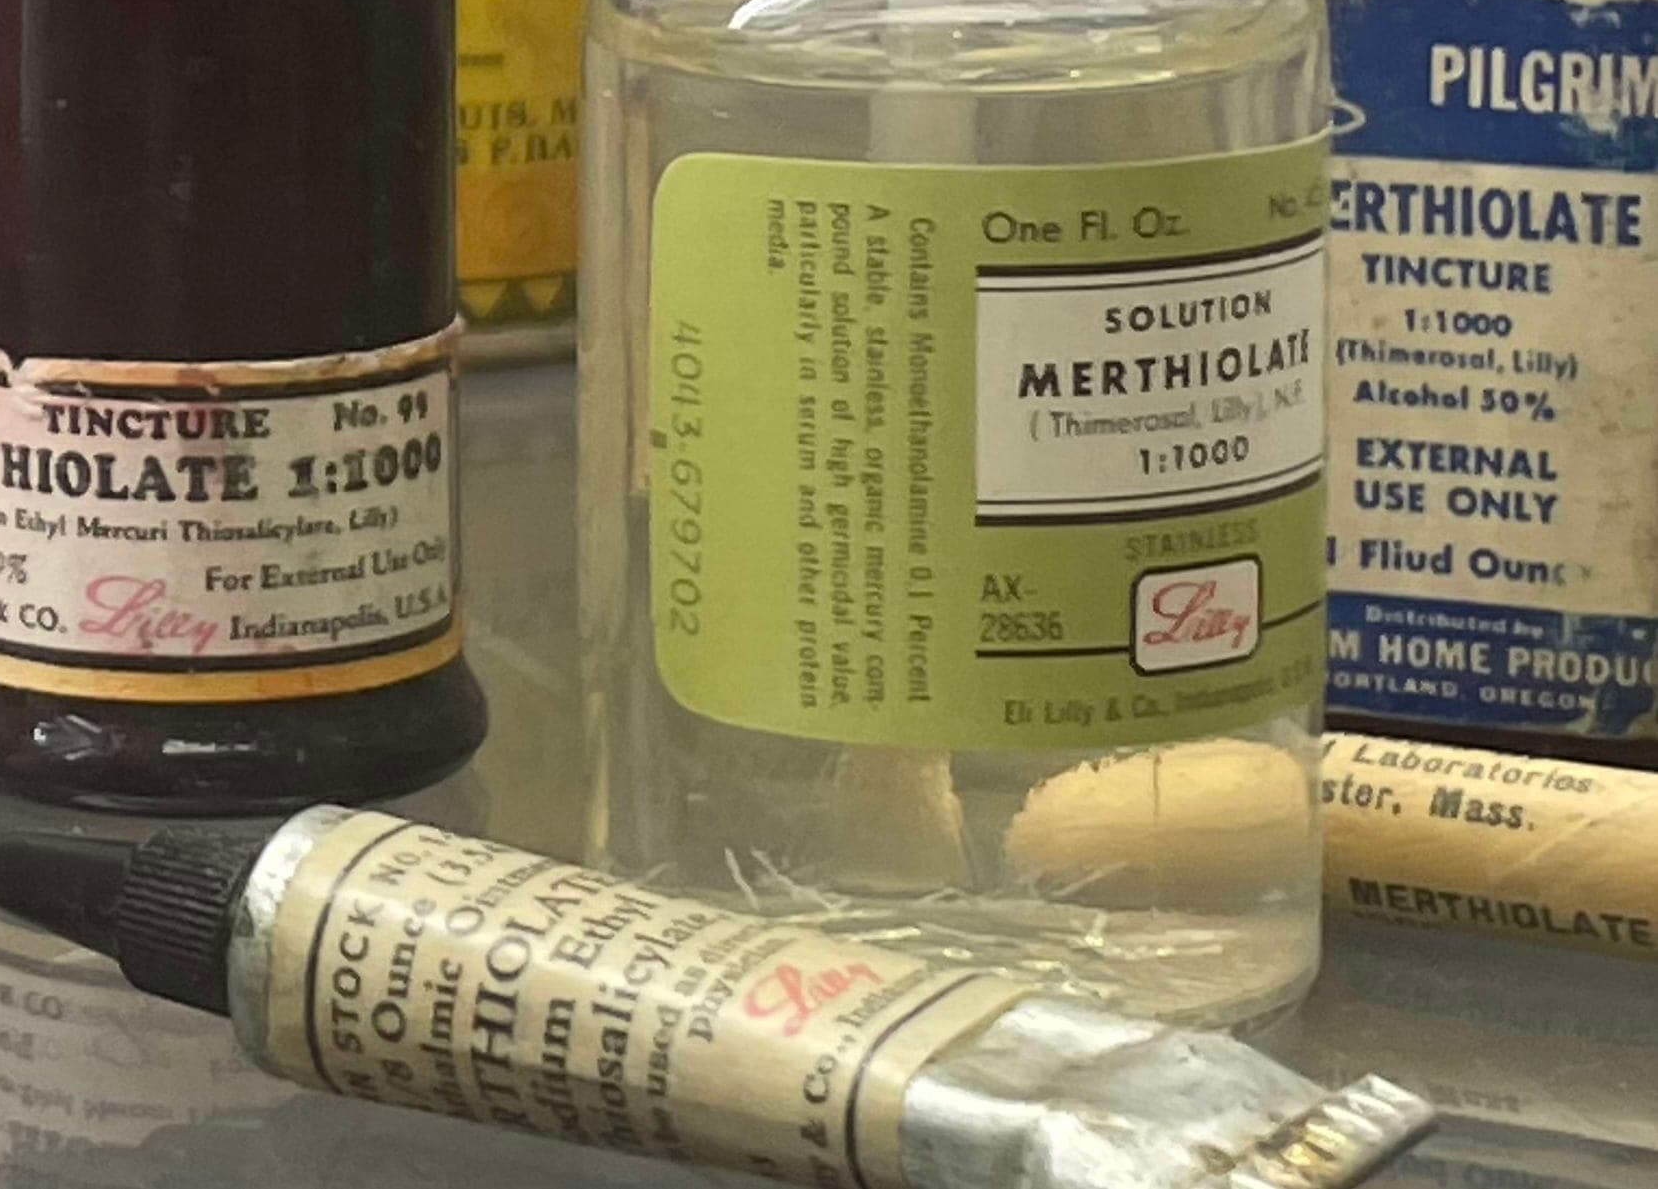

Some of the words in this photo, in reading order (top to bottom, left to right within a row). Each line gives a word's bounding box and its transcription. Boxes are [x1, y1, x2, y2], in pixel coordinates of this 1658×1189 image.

[1429, 44, 1658, 119] PILGRIM
[865, 203, 891, 222] A
[982, 211, 1062, 244] One
[1080, 211, 1118, 241] Fl.
[827, 201, 856, 278] pound
[793, 200, 823, 344] particularly
[908, 216, 937, 321] Contains
[1361, 252, 1552, 294] TINCTURE
[830, 291, 859, 384] solution
[1105, 289, 1272, 334] SOLUTION
[1405, 308, 1513, 337] 1:1000
[798, 356, 818, 381] in
[1018, 328, 1311, 399] MERTHIOLATE
[42, 405, 271, 440] TINCTURE
[332, 401, 388, 431] No.
[830, 398, 857, 423] of
[1353, 379, 1469, 410] Alcohol
[797, 394, 818, 471] serum
[908, 332, 936, 556] Monoethanolamine
[1140, 434, 1251, 476] 1:1000
[1356, 436, 1559, 481] EXTERNAL
[288, 432, 442, 498] 1:1000
[826, 436, 856, 489] high
[797, 483, 823, 529] and
[860, 445, 886, 534] organic
[1354, 479, 1426, 512] USE
[1447, 486, 1559, 525] ONLY
[14, 508, 67, 540] Ethyl
[76, 515, 169, 542] Mercuri
[1124, 518, 1260, 562] STAINLESS
[204, 565, 253, 593] For
[259, 552, 367, 591] External
[371, 550, 409, 576] Use
[798, 541, 821, 608] other
[826, 501, 856, 627] germicidal
[908, 565, 934, 599] 0.1
[1358, 538, 1454, 576] Fliud
[18, 602, 69, 634] CO.
[79, 574, 219, 652] Lilly
[861, 545, 886, 643] mercury
[1143, 580, 1251, 649] Lilly
[794, 618, 820, 709] protein
[907, 613, 934, 702] Percent
[1378, 632, 1492, 675] HOME
[1479, 684, 1598, 712] OREGON
[1352, 742, 1594, 793] Laboratories
[1429, 784, 1535, 832] Mass.
[550, 893, 660, 970] Ethyl
[1348, 876, 1656, 948] MERTHIOLATE
[330, 898, 385, 1054] STOCK
[371, 898, 437, 1044] Ounce
[646, 1005, 684, 1099] used
